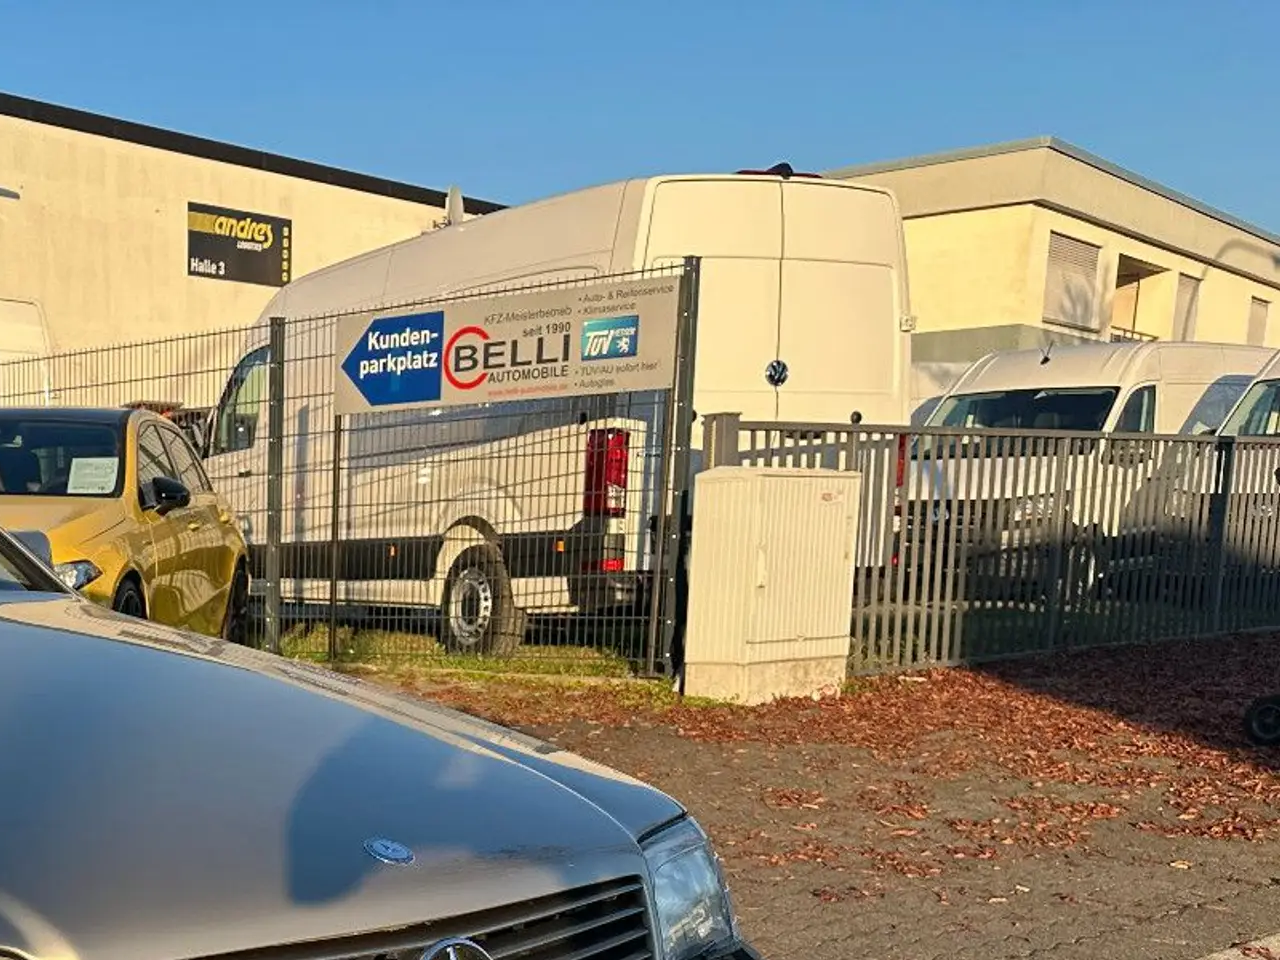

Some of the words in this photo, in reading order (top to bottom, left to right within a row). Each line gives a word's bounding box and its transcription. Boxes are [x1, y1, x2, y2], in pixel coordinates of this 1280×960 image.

[214, 216, 273, 249] andres
[190, 257, 217, 274] Halle
[218, 261, 226, 275] 3
[484, 307, 572, 325] KFZ-Meisterbetrieb
[368, 327, 439, 351] Kunden-
[523, 325, 543, 337] seit
[546, 322, 571, 335] 1990
[454, 334, 570, 372] BELLI
[359, 351, 438, 379] parkplatz
[488, 365, 569, 383] AUTOMOBILE
